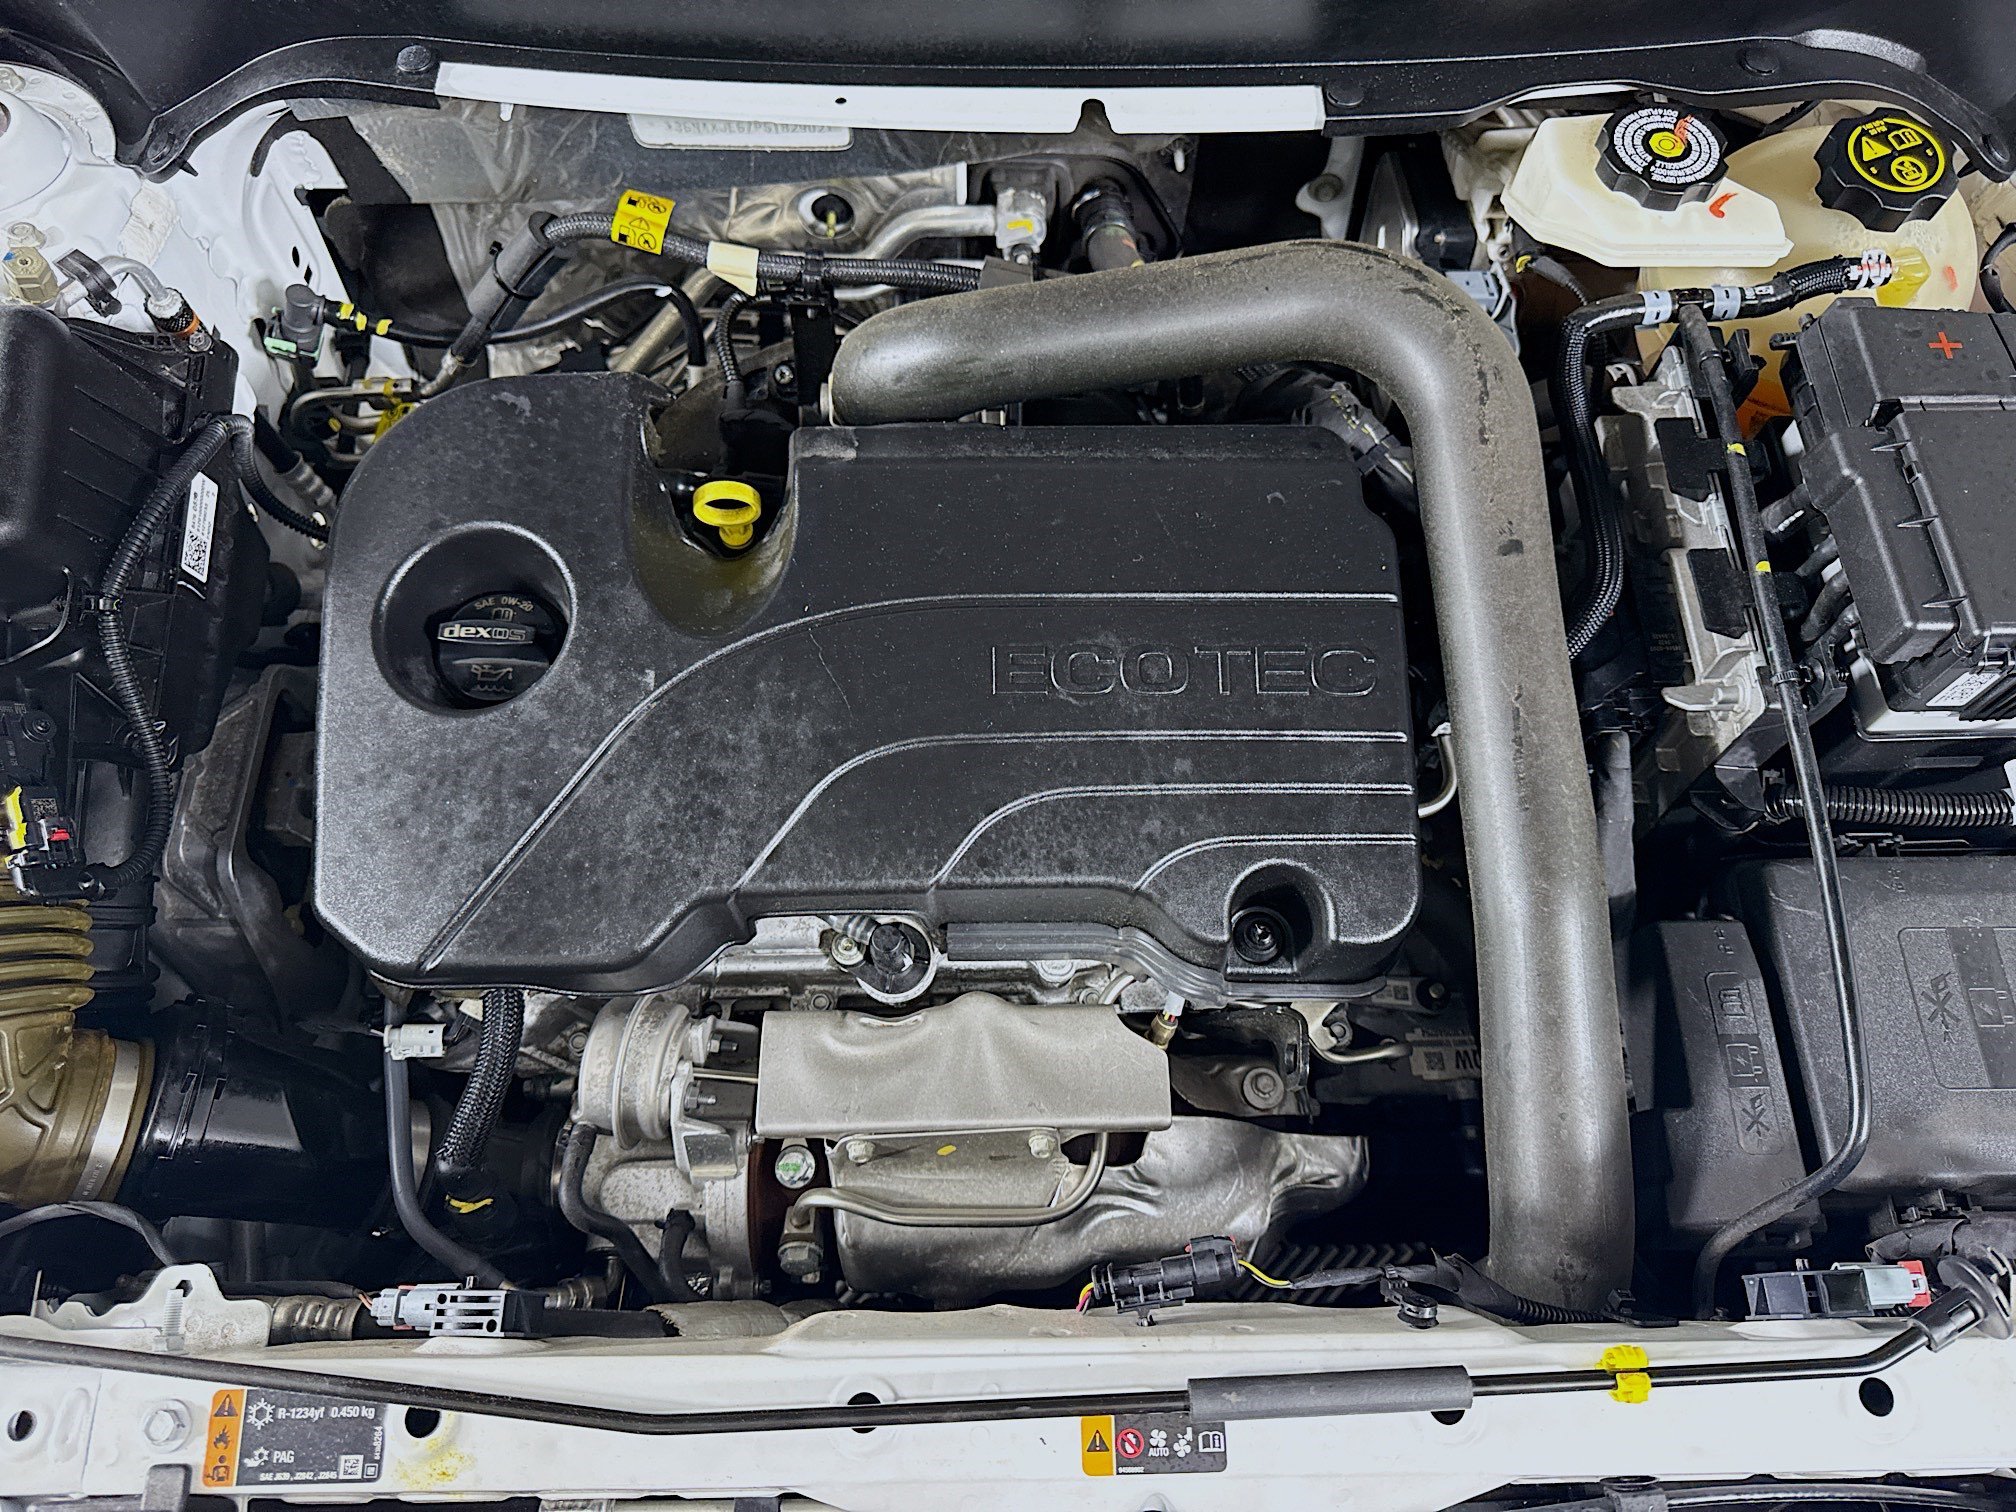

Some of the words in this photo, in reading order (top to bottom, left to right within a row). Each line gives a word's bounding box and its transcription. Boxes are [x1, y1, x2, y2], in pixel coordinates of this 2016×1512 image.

[474, 598, 496, 610] SAE
[501, 596, 534, 612] 0W-20
[443, 623, 526, 641] dexos
[991, 643, 1376, 696] ECOTEC
[277, 1407, 325, 1422] R-1234yf
[331, 1406, 359, 1419] 0.450
[361, 1406, 376, 1420] kg
[273, 1450, 295, 1464] PAG
[1148, 1447, 1170, 1457] AUTO
